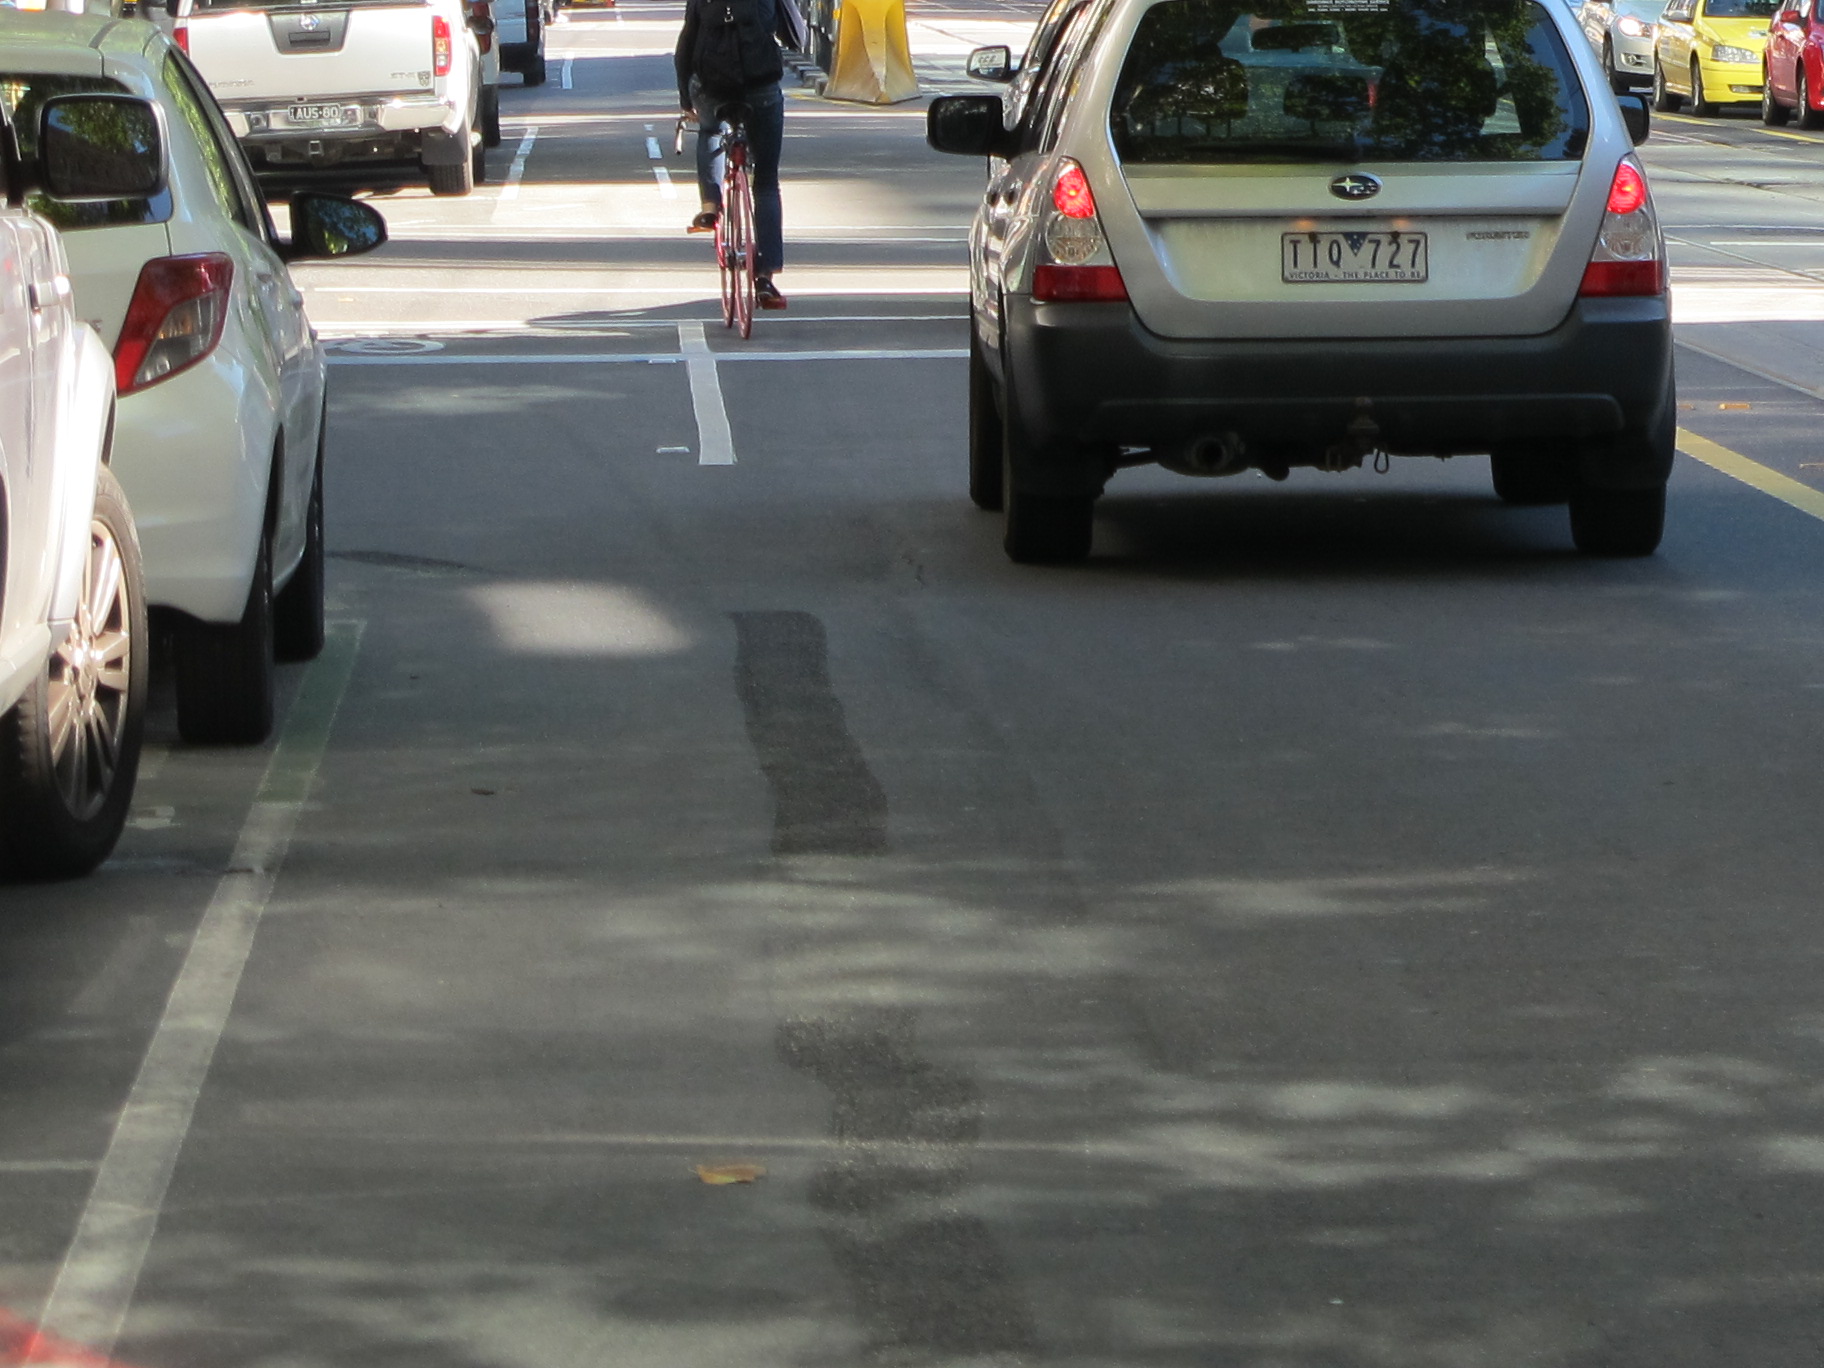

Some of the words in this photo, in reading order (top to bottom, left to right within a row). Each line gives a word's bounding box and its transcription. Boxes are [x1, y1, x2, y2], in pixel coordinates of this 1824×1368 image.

[1289, 239, 1342, 269] TTQ
[1368, 238, 1421, 269] 727
[1289, 271, 1330, 279] VICTORIA
[1343, 271, 1359, 279] THE
[1363, 271, 1389, 279] PLACE
[1394, 271, 1406, 279] TO
[1411, 271, 1421, 279] BE
